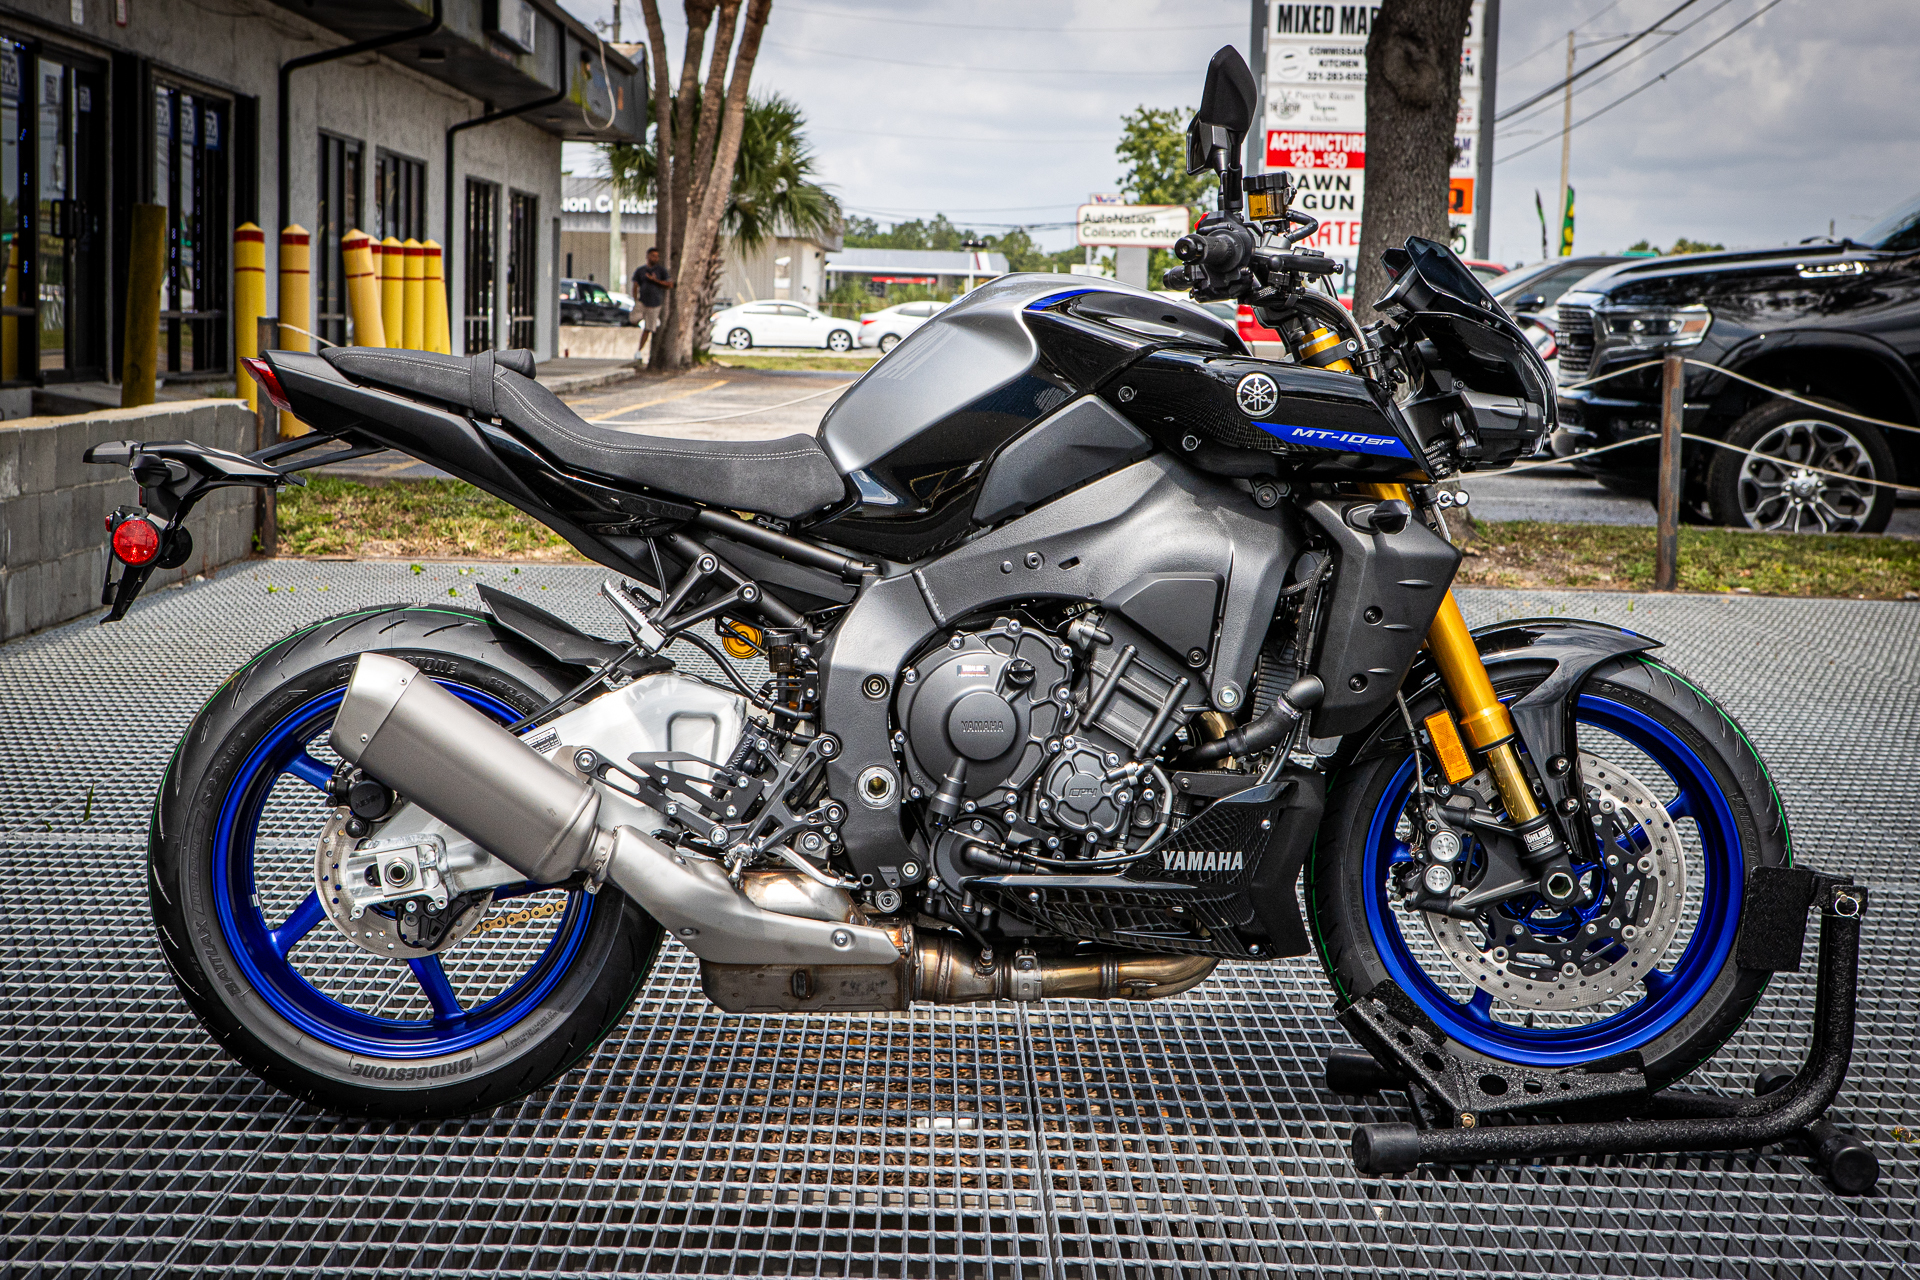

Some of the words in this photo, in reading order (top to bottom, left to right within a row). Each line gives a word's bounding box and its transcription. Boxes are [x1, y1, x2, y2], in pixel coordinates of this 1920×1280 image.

[1277, 4, 1334, 34] MIXED
[1318, 60, 1359, 69] KITCHEN
[1291, 174, 1351, 191] AWN
[560, 196, 592, 213] ion
[1302, 193, 1354, 210] GUN
[1084, 213, 1155, 224] AutoNation
[1082, 226, 1137, 237] Collision
[1141, 227, 1182, 238] Center
[961, 720, 1004, 733] YAMAHA
[1161, 850, 1243, 871] YAMAHA
[196, 920, 242, 997] BATTLAX
[350, 1056, 473, 1081] BRIDGESTONE
